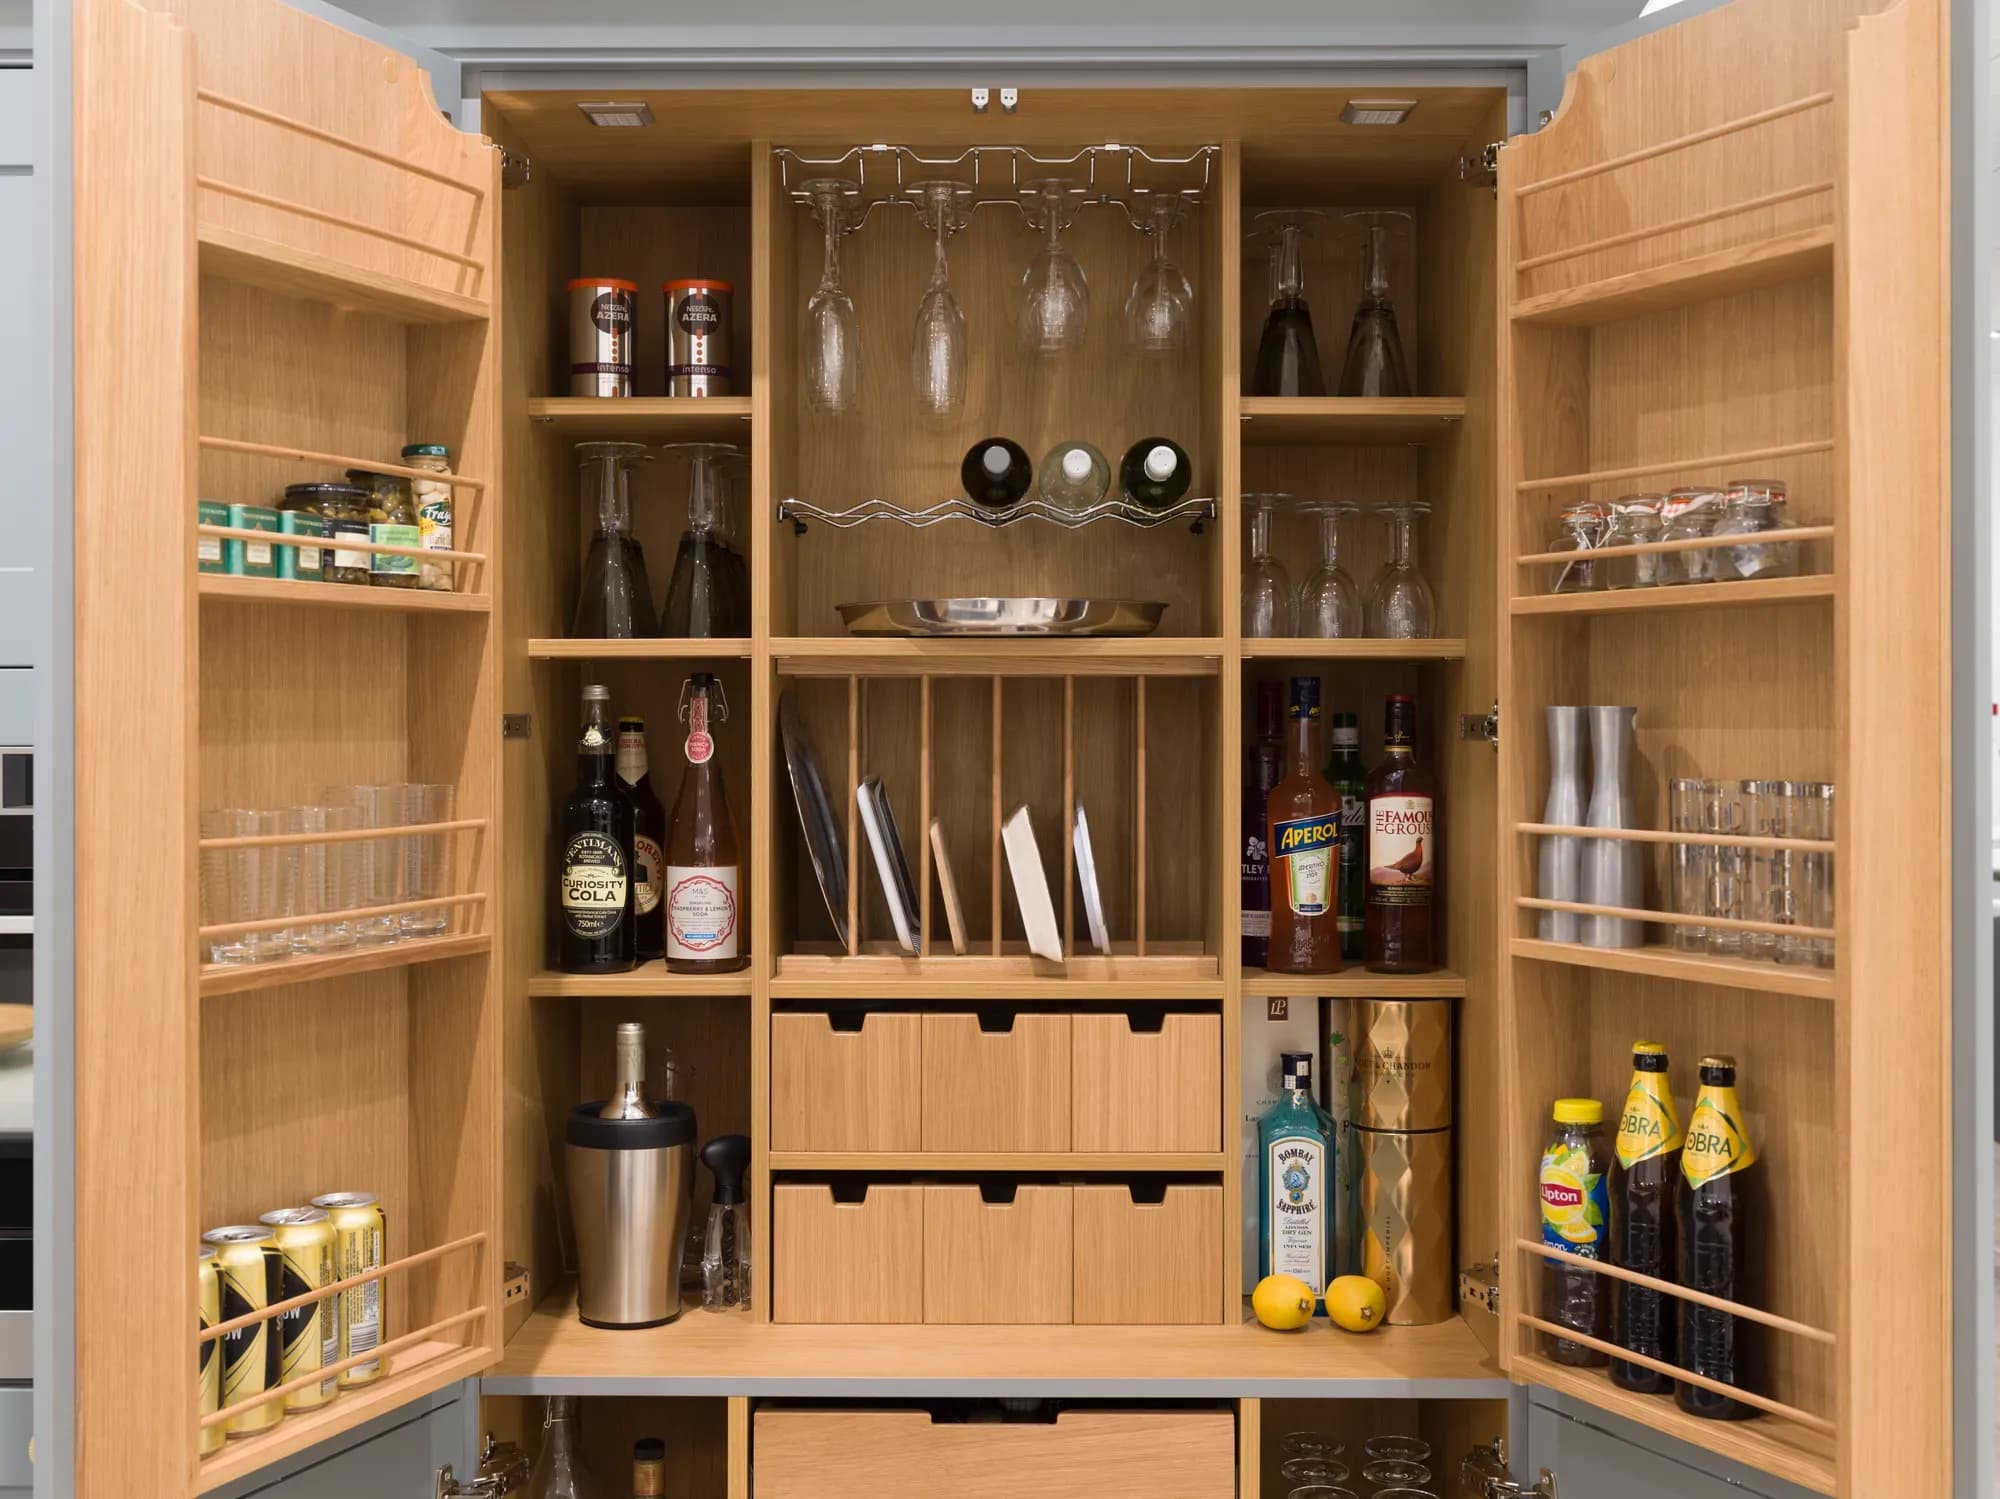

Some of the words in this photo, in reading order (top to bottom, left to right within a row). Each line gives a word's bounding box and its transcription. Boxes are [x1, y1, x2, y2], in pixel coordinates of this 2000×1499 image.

[596, 311, 630, 321] AZERA
[682, 313, 718, 322] AZERA
[597, 363, 630, 373] intenso
[682, 366, 717, 375] intenso
[1376, 810, 1385, 833] THE
[1385, 810, 1432, 824] FAMOU
[1384, 822, 1432, 835] GROUS
[1281, 822, 1338, 851] APEROL
[563, 878, 624, 889] CURIOSITY
[568, 888, 617, 902] COLA
[1382, 1060, 1432, 1071] CHANDON
[1620, 1114, 1661, 1139] OBRA
[1685, 1131, 1733, 1159] OBRA
[1278, 1148, 1316, 1165] BOMBAY
[1542, 1187, 1578, 1202] Lipton
[1276, 1199, 1316, 1215] SAPPHIRE
